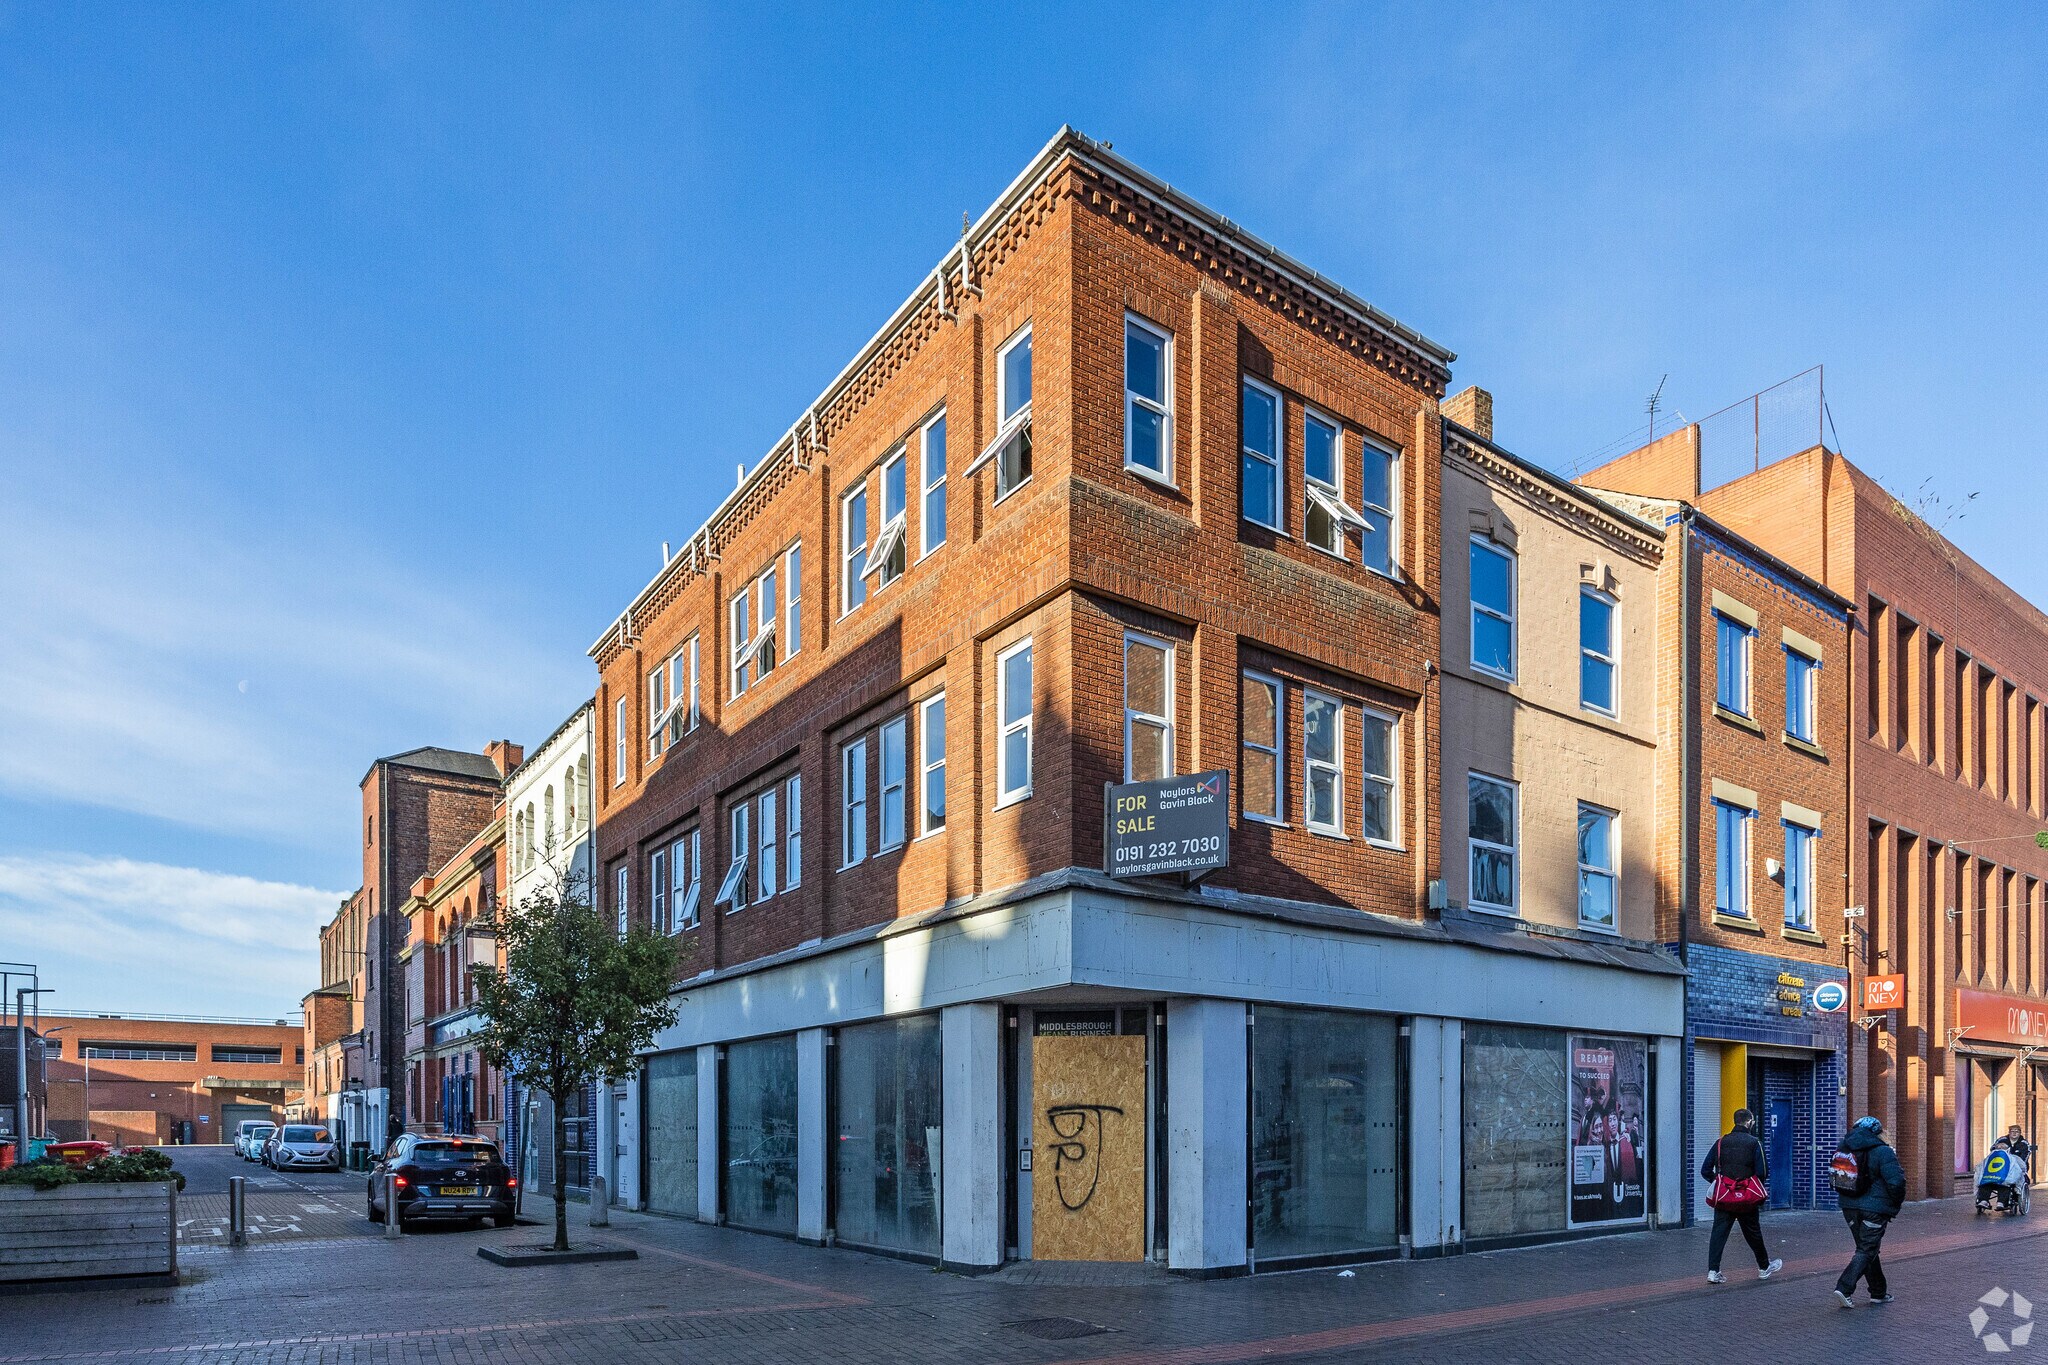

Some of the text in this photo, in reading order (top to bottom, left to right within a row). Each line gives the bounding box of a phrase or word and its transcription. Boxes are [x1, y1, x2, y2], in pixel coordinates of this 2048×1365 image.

[1160, 786, 1196, 800] Naylors
[1116, 795, 1146, 813] FOR
[1160, 794, 1214, 810] Gavin Black
[1116, 816, 1156, 835] SALE
[1116, 836, 1220, 862] 0191 232 7030
[1115, 854, 1220, 874] naylorsgavinblack.co.uk
[1778, 972, 1804, 987] citizens
[1868, 992, 1898, 1004] NEY
[1040, 1022, 1112, 1030] MIDDLESBROUGH
[1580, 1054, 1608, 1064] READY
